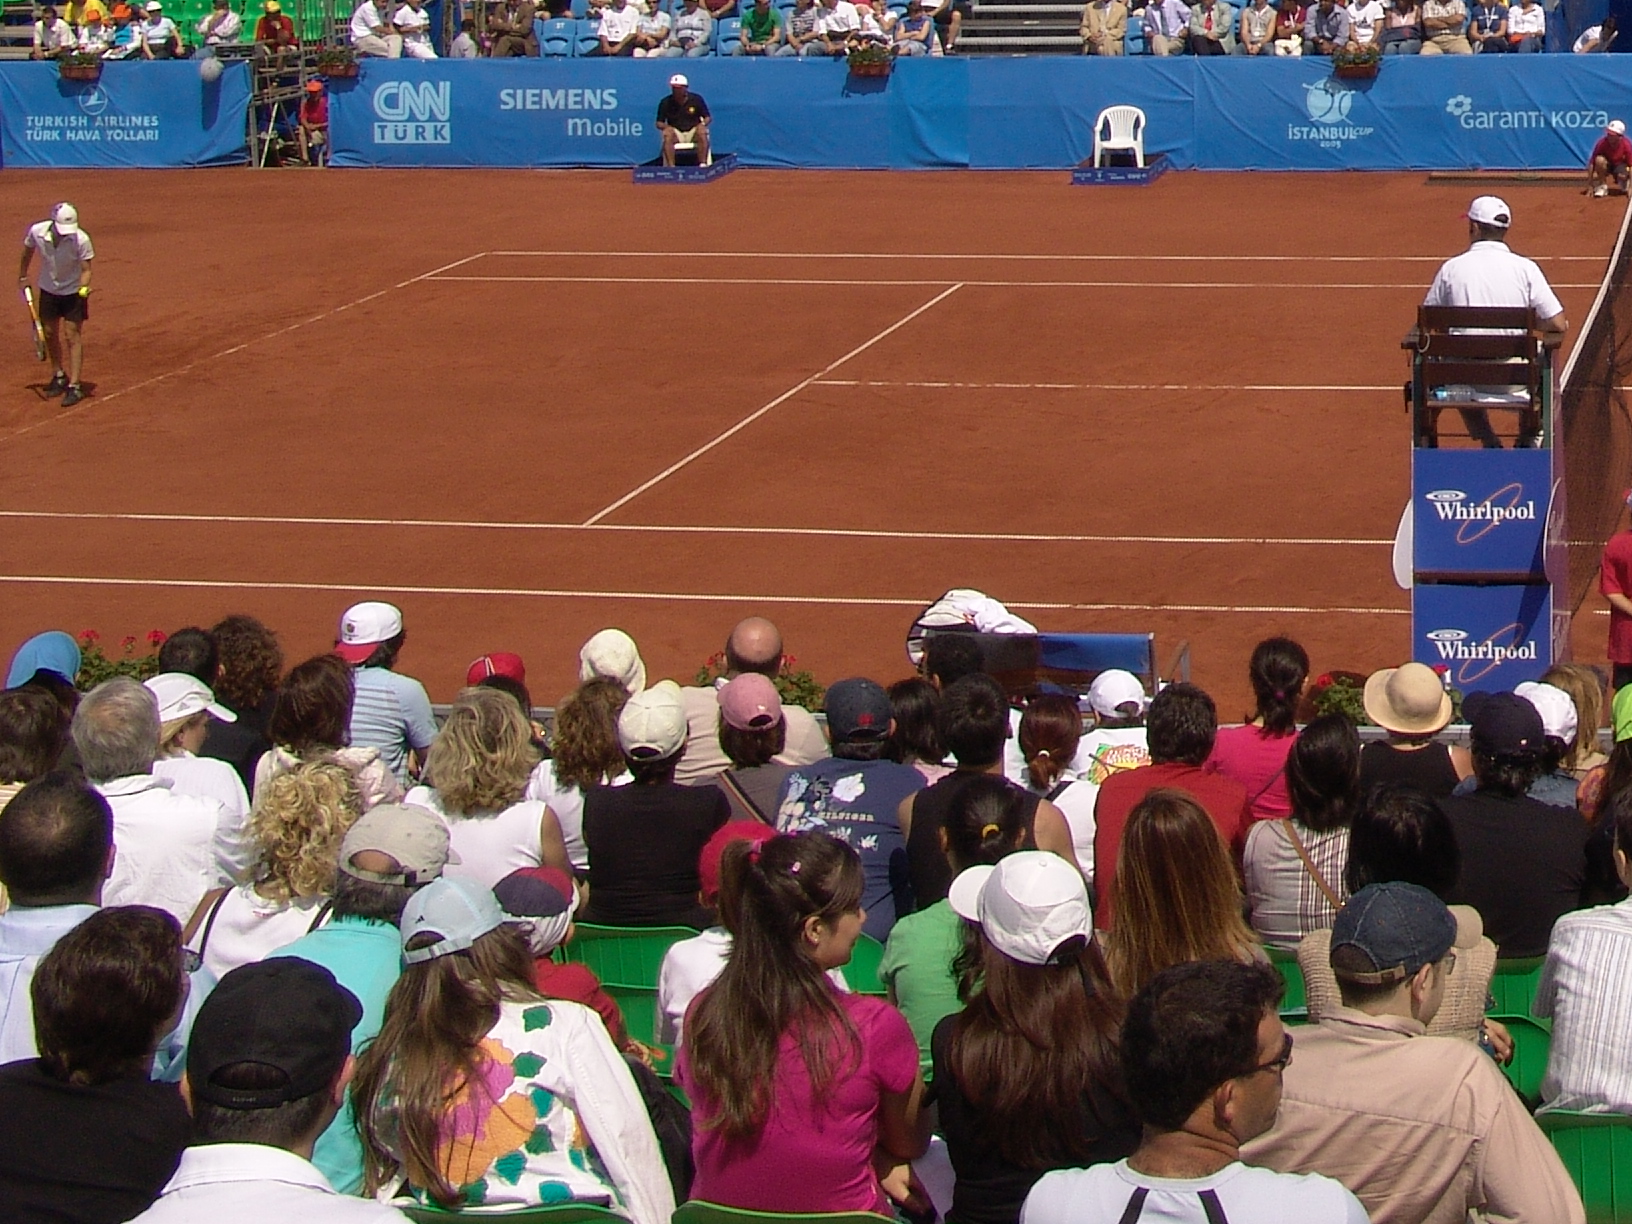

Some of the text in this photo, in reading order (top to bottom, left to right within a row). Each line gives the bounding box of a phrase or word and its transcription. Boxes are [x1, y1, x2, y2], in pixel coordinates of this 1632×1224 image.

[373, 81, 450, 121] CNN
[499, 89, 618, 110] SIEMENS
[26, 115, 159, 127] TURKISH AIRLINES
[567, 117, 643, 137] mobile
[26, 128, 159, 141] TÜRK HAVA YOLLARI
[376, 123, 449, 143] TÜRK
[1434, 501, 1536, 526] Whirlpool
[1435, 641, 1537, 665] Whirlpool
